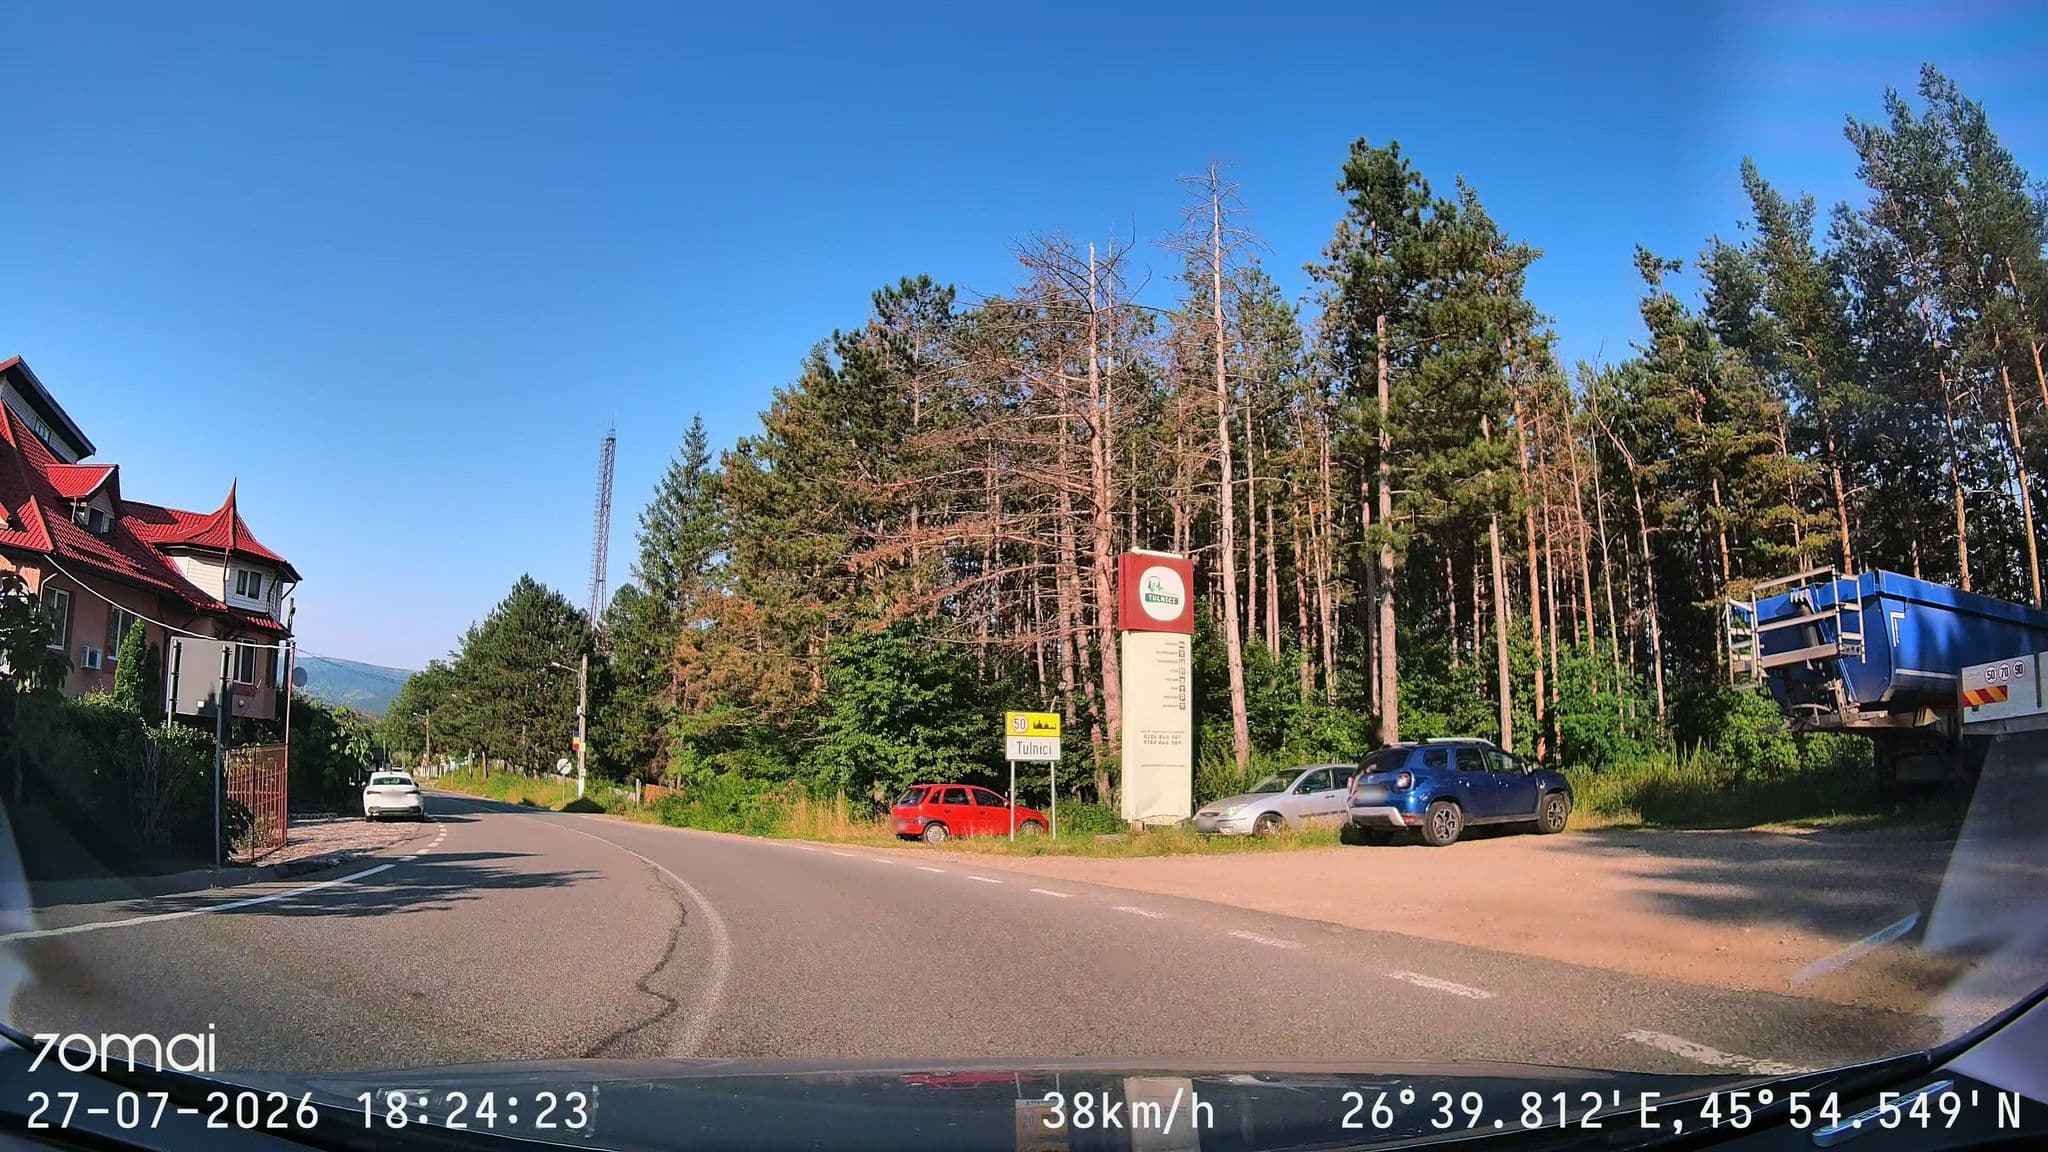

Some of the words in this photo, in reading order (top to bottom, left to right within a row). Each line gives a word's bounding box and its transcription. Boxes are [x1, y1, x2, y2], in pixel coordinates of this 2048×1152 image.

[1987, 669, 1995, 680] 50
[2000, 667, 2009, 677] 70
[2014, 664, 2023, 675] 90
[1014, 718, 1026, 730] 50
[1016, 741, 1052, 755] Tulnici
